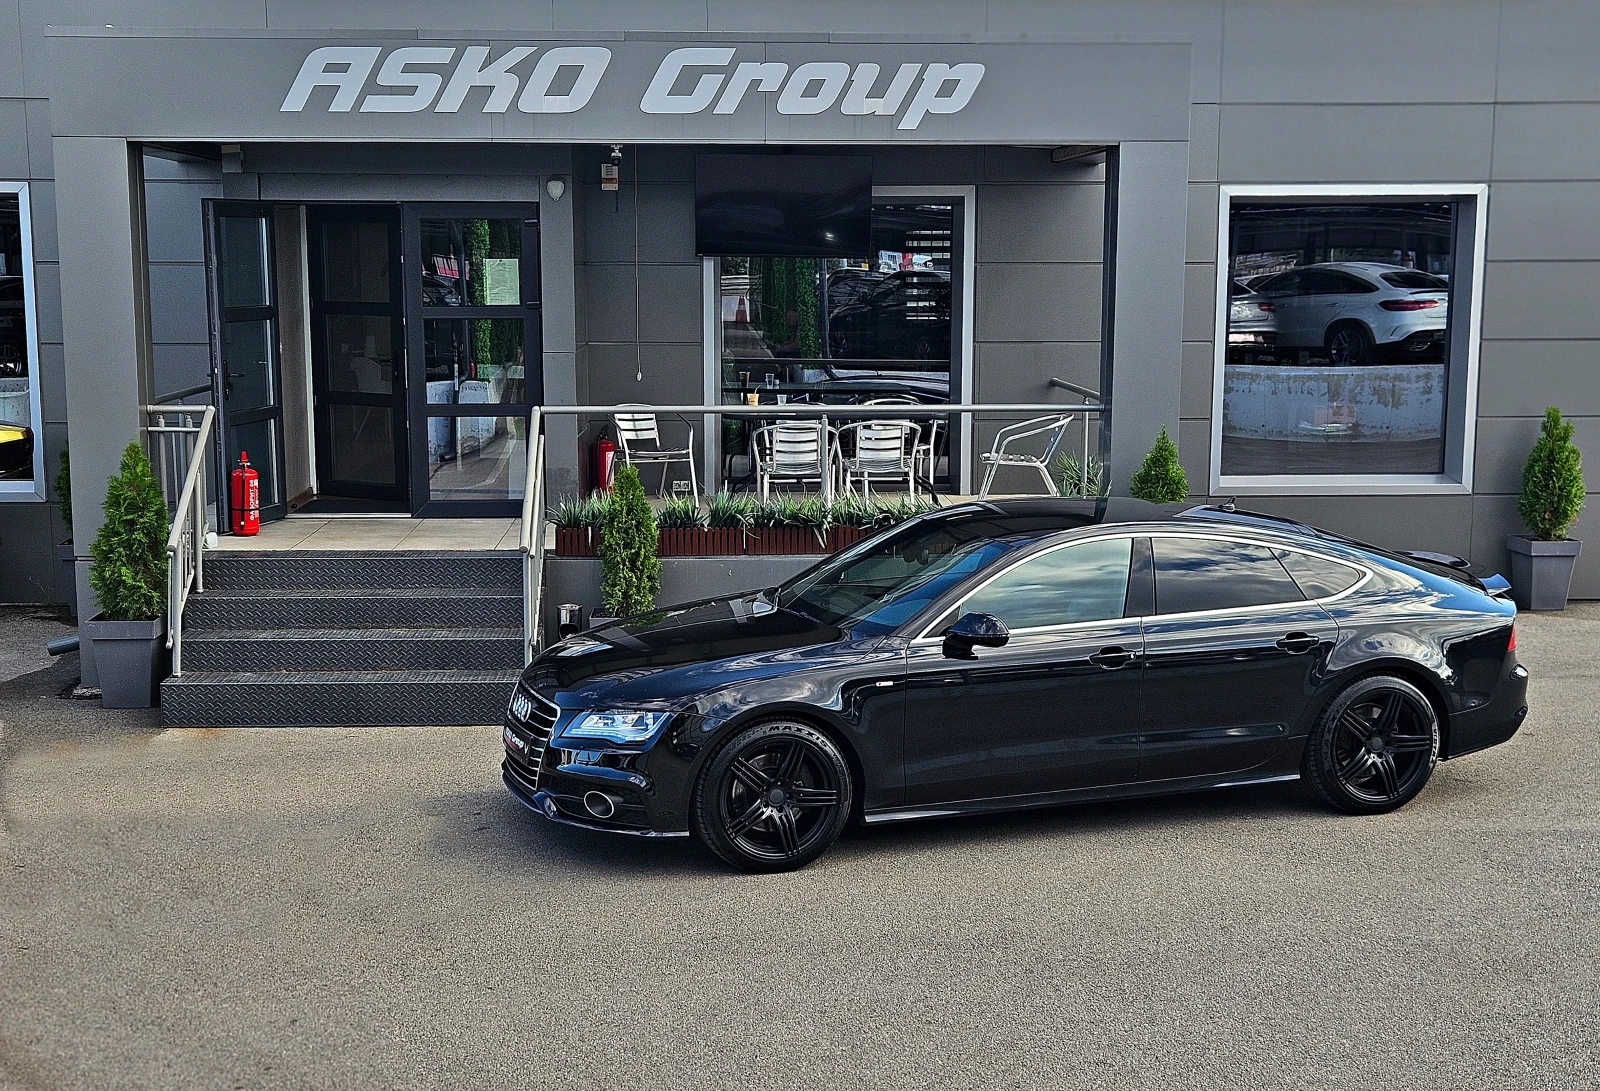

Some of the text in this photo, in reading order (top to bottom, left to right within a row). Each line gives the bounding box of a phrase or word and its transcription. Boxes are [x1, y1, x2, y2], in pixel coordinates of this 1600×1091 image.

[280, 47, 985, 130] ASKO Group
[768, 725, 829, 748] MAXXIS
